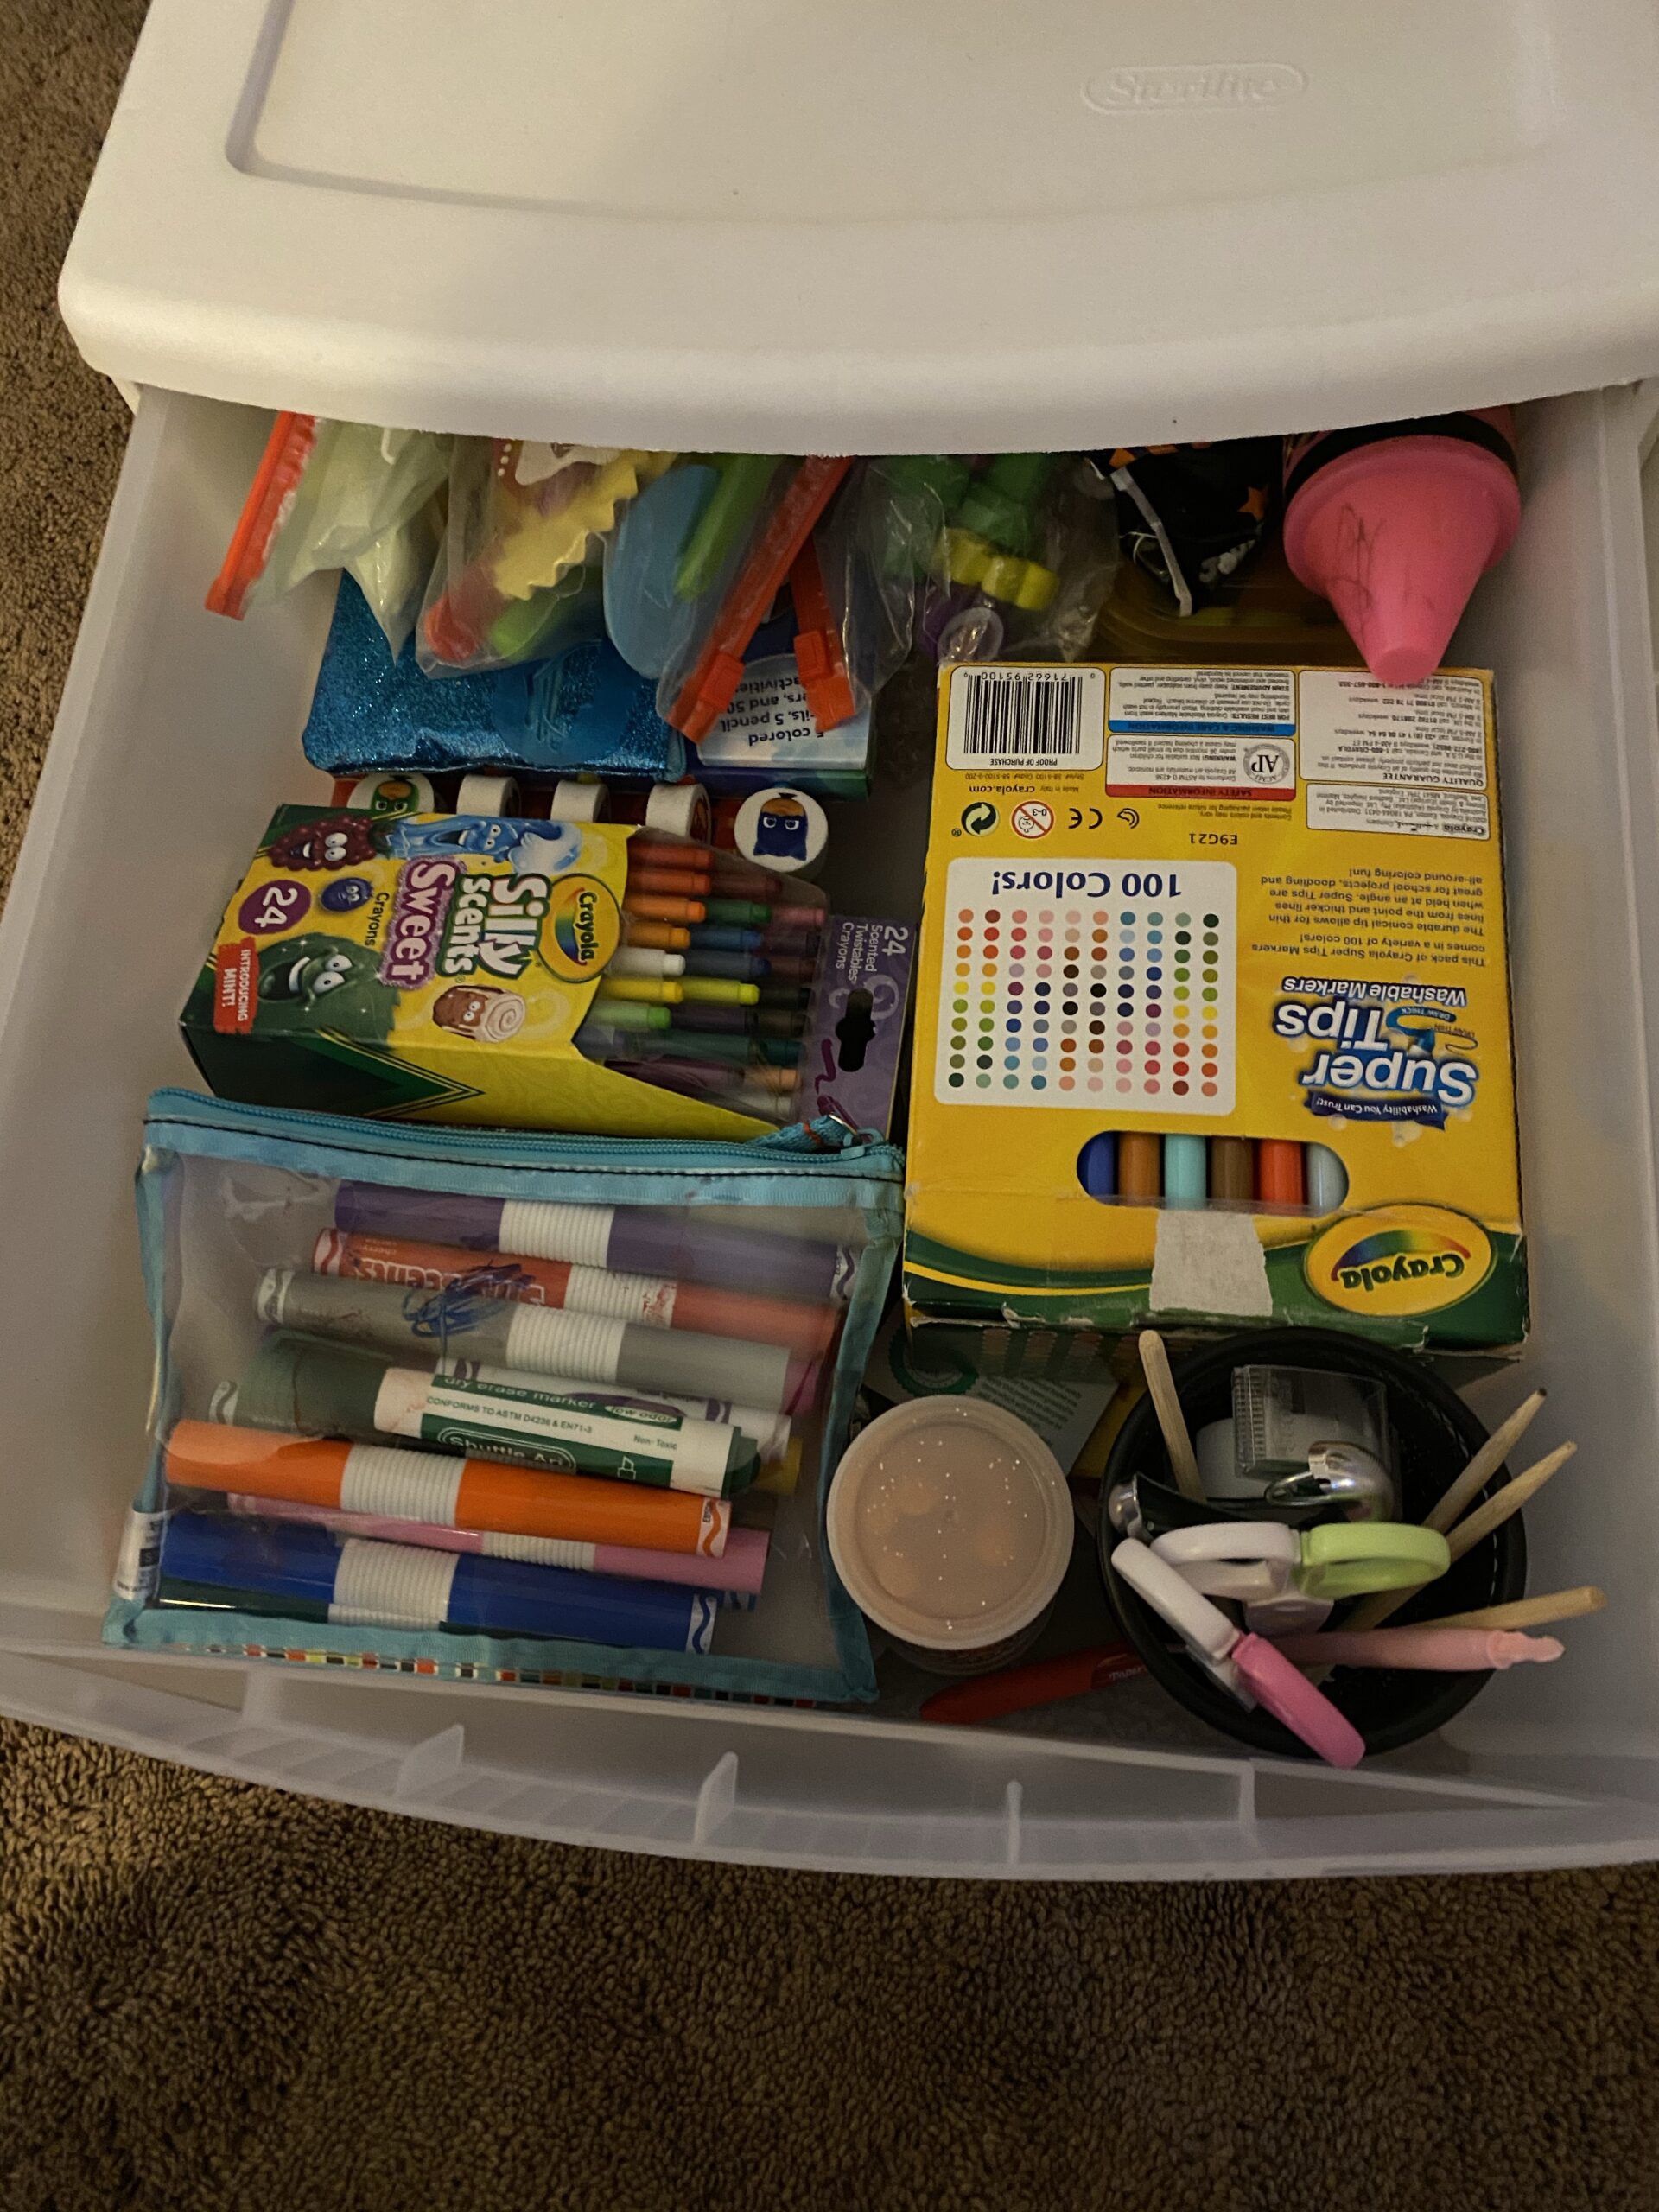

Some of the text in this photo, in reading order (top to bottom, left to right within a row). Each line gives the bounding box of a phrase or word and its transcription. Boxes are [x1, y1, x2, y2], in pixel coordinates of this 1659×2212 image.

[749, 696, 779, 710] and
[720, 712, 770, 732] pencil
[748, 728, 810, 746] colored
[1250, 754, 1278, 773] AP
[969, 785, 1035, 794] crayola.com
[1382, 772, 1484, 786] QUALITY GUARANTEE
[1148, 787, 1215, 796] INFORMATION
[1444, 824, 1484, 836] Crayola
[992, 871, 1181, 899] 100 Colors!
[1261, 876, 1483, 898] great for school projects, doodling and
[1349, 868, 1483, 886] all-around coloring fun!
[1270, 889, 1288, 898] are
[1292, 888, 1315, 901] Tips
[1319, 890, 1353, 903] Super
[1356, 892, 1390, 906] angle.
[1411, 898, 1422, 907] at
[1426, 899, 1450, 909] held
[254, 887, 298, 928] 24
[1275, 902, 1484, 924] lines from the point and thicker lines
[1453, 900, 1483, 911] when
[365, 892, 390, 946] Crayons
[391, 863, 456, 981] Sweet
[444, 877, 491, 975] scents
[478, 876, 549, 976] Silly
[578, 892, 600, 961] Crayola
[1268, 914, 1484, 936] The durable conical tip allows for thin
[836, 922, 855, 969] Crayons
[865, 924, 883, 972] Scented
[882, 925, 909, 957] 24
[1300, 934, 1340, 945] colors!
[1344, 937, 1363, 947] 100
[1367, 938, 1378, 948] of
[1382, 937, 1421, 950] variety
[1433, 942, 1444, 951] in
[1447, 943, 1485, 952] comes
[848, 923, 868, 982] Twistables
[1251, 944, 1485, 966] This pack of Crayola Super Tips Markers
[221, 968, 238, 1007] MINT!
[238, 949, 251, 1022] INTRODUCING
[1283, 978, 1466, 1006] Washable Markers
[1276, 1001, 1388, 1051] Tips
[1301, 1052, 1477, 1106] Super
[1316, 1097, 1437, 1114] Washability You Can Trust!
[1337, 1253, 1465, 1292] Crayola
[427, 1396, 480, 1412] CONFORMS
[482, 1406, 494, 1415] TO
[496, 1408, 522, 1421] ASTM
[477, 1382, 527, 1397] erase
[533, 1391, 597, 1409] marker
[610, 1406, 636, 1416] low
[640, 1412, 673, 1422] odor
